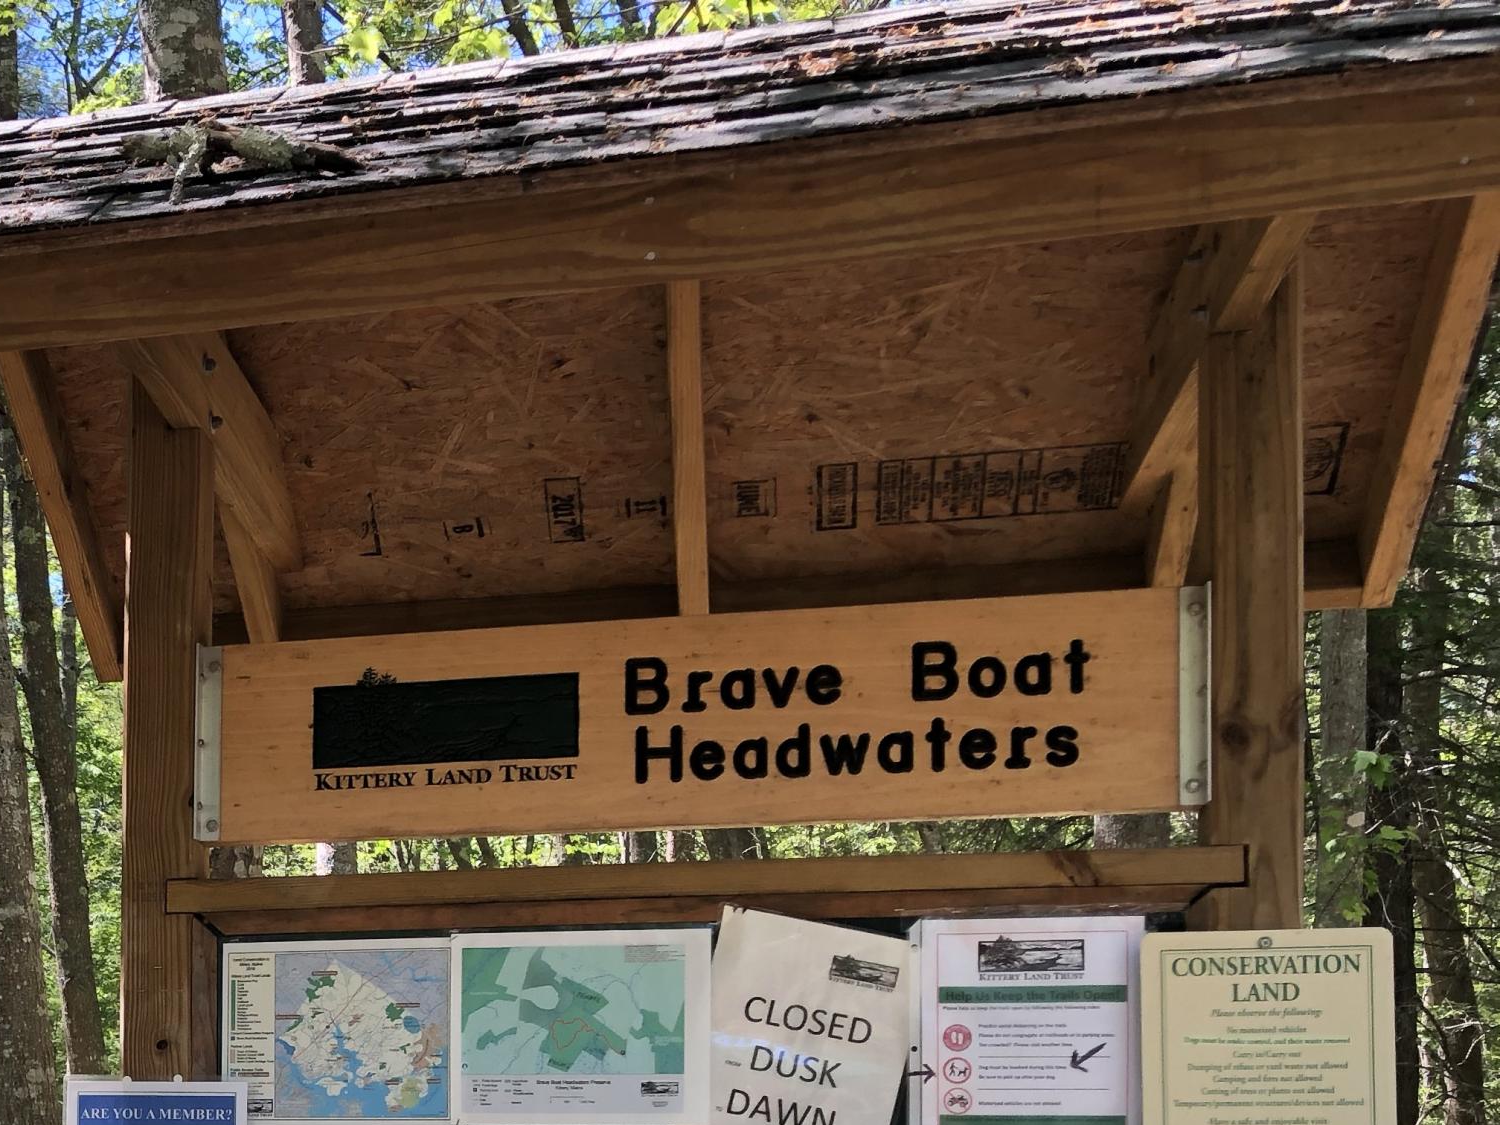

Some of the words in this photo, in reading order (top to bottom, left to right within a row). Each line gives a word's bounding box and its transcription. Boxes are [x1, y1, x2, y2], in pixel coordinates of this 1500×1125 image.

[551, 494, 577, 527] 2017
[625, 657, 843, 715] Brave
[911, 639, 1090, 701] Boat
[635, 717, 1080, 783] Headwaters
[315, 772, 417, 791] KITTERY
[425, 768, 491, 785] LAND
[499, 764, 577, 782] TRUST
[1053, 972, 1084, 980] TRUST
[1172, 954, 1361, 976] CONSERVATION
[1232, 982, 1300, 1002] LAND
[744, 997, 872, 1043] CLOSED
[750, 1046, 841, 1087] DUSK
[81, 1108, 110, 1119] ARE
[114, 1108, 142, 1119] YOU
[146, 1109, 156, 1119] A
[159, 1109, 232, 1120] MEMBER?
